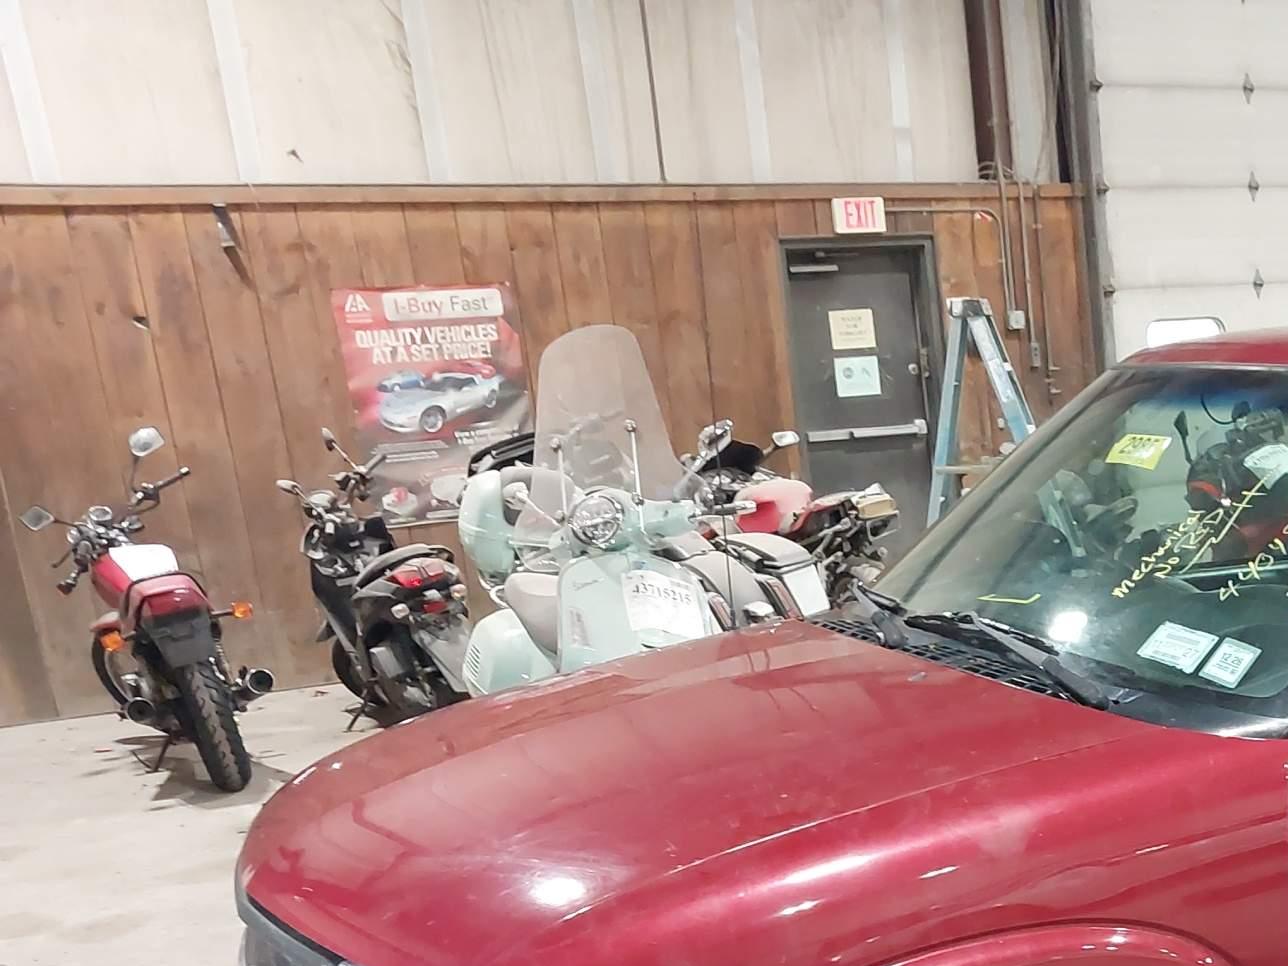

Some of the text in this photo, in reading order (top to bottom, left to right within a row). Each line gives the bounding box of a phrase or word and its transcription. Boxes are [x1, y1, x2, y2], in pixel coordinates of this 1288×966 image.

[844, 200, 877, 229] EXIT
[394, 295, 489, 315] I-Buy Fast
[355, 324, 499, 348] QUALITY VEHICLES
[372, 342, 492, 365] AT A SET PRICE!
